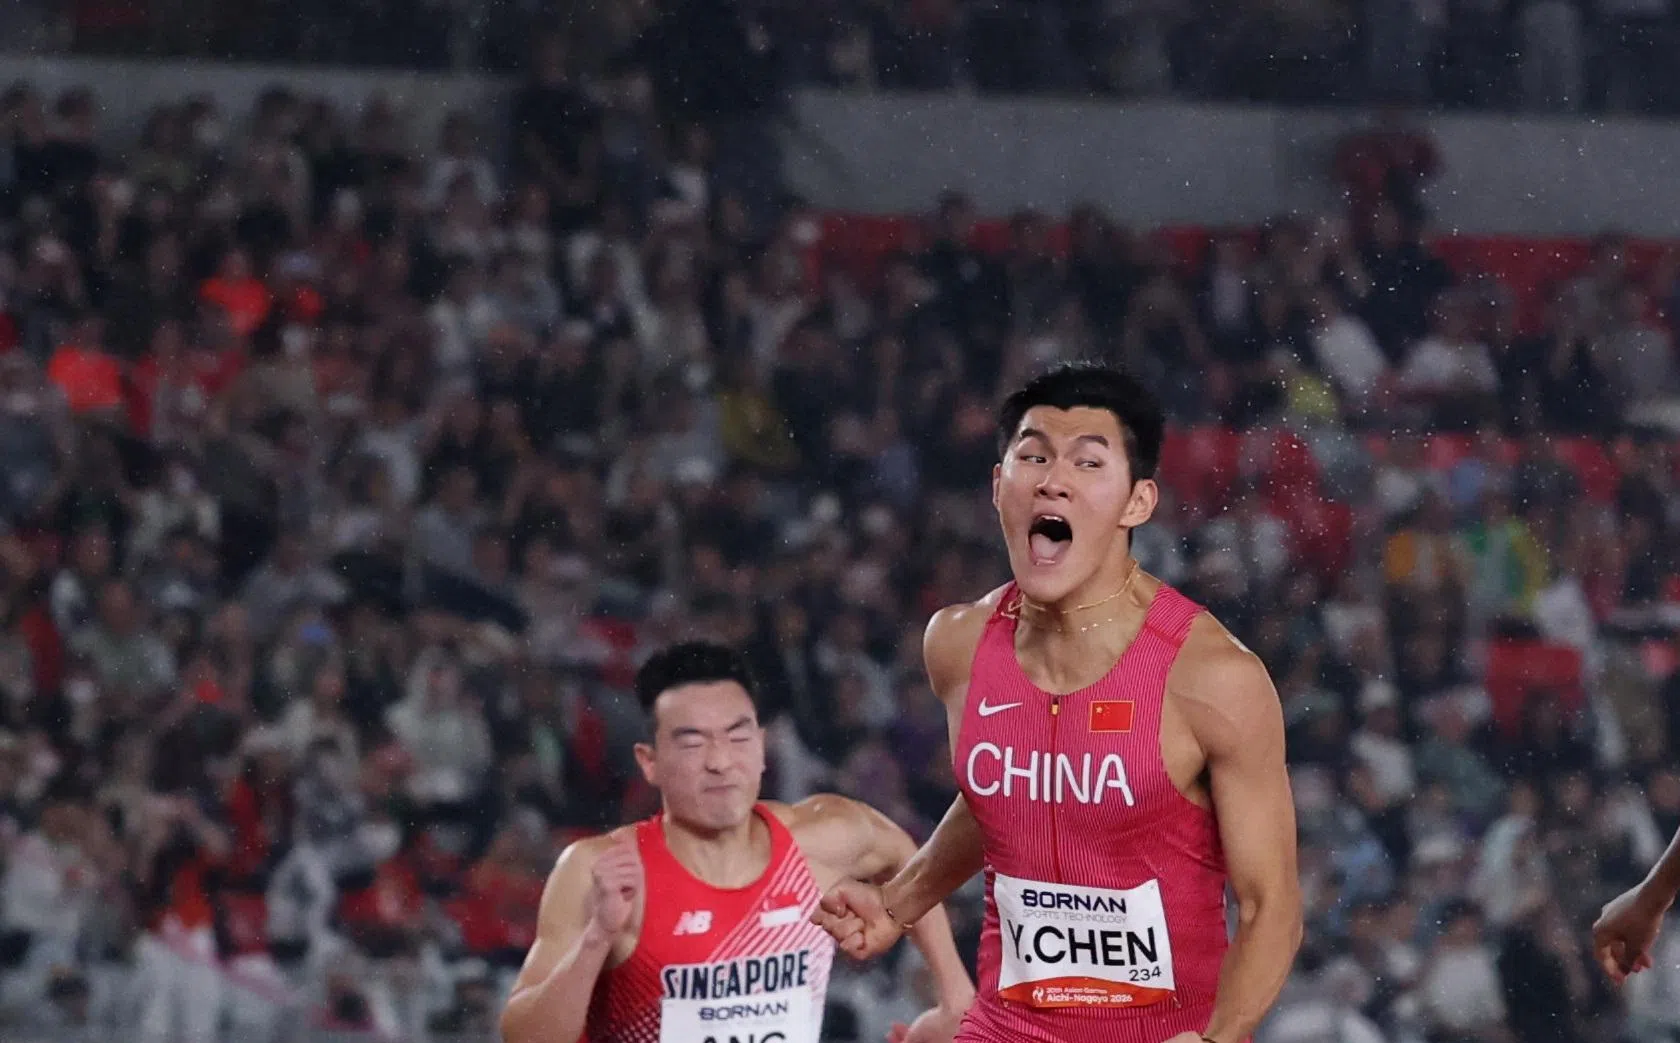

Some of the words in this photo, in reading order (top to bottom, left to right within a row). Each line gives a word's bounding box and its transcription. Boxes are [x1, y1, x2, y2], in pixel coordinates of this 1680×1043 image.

[967, 742, 1134, 806] CHINA
[1021, 889, 1127, 913] BORNAN
[1007, 919, 1159, 967] Y.CHEN
[664, 950, 810, 1000] SINGAPORE
[1129, 966, 1162, 981] 234
[698, 1001, 788, 1021] BORNAN
